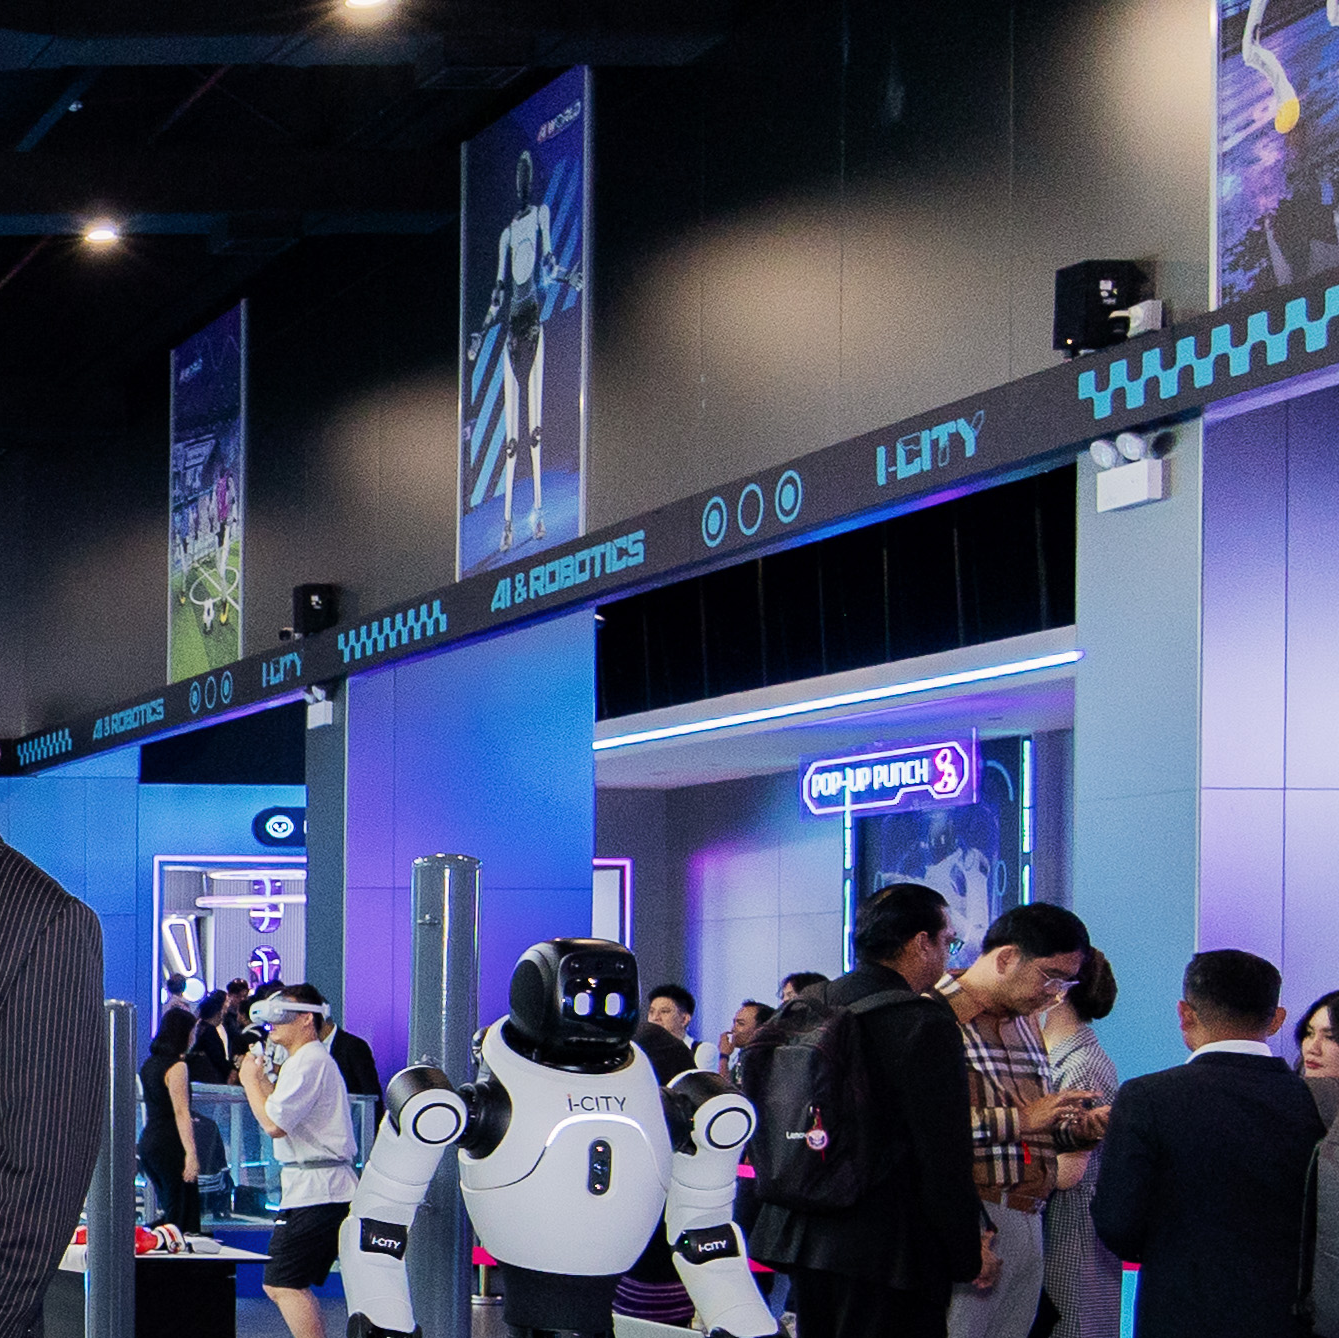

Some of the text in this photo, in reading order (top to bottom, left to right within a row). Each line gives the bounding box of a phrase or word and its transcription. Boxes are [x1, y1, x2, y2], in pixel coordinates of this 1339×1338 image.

[491, 529, 645, 613] AI & ROBOTICS
[92, 718, 103, 741] AI
[111, 698, 164, 735] ROBOTICS
[811, 758, 929, 798] POP-UP PUNCH
